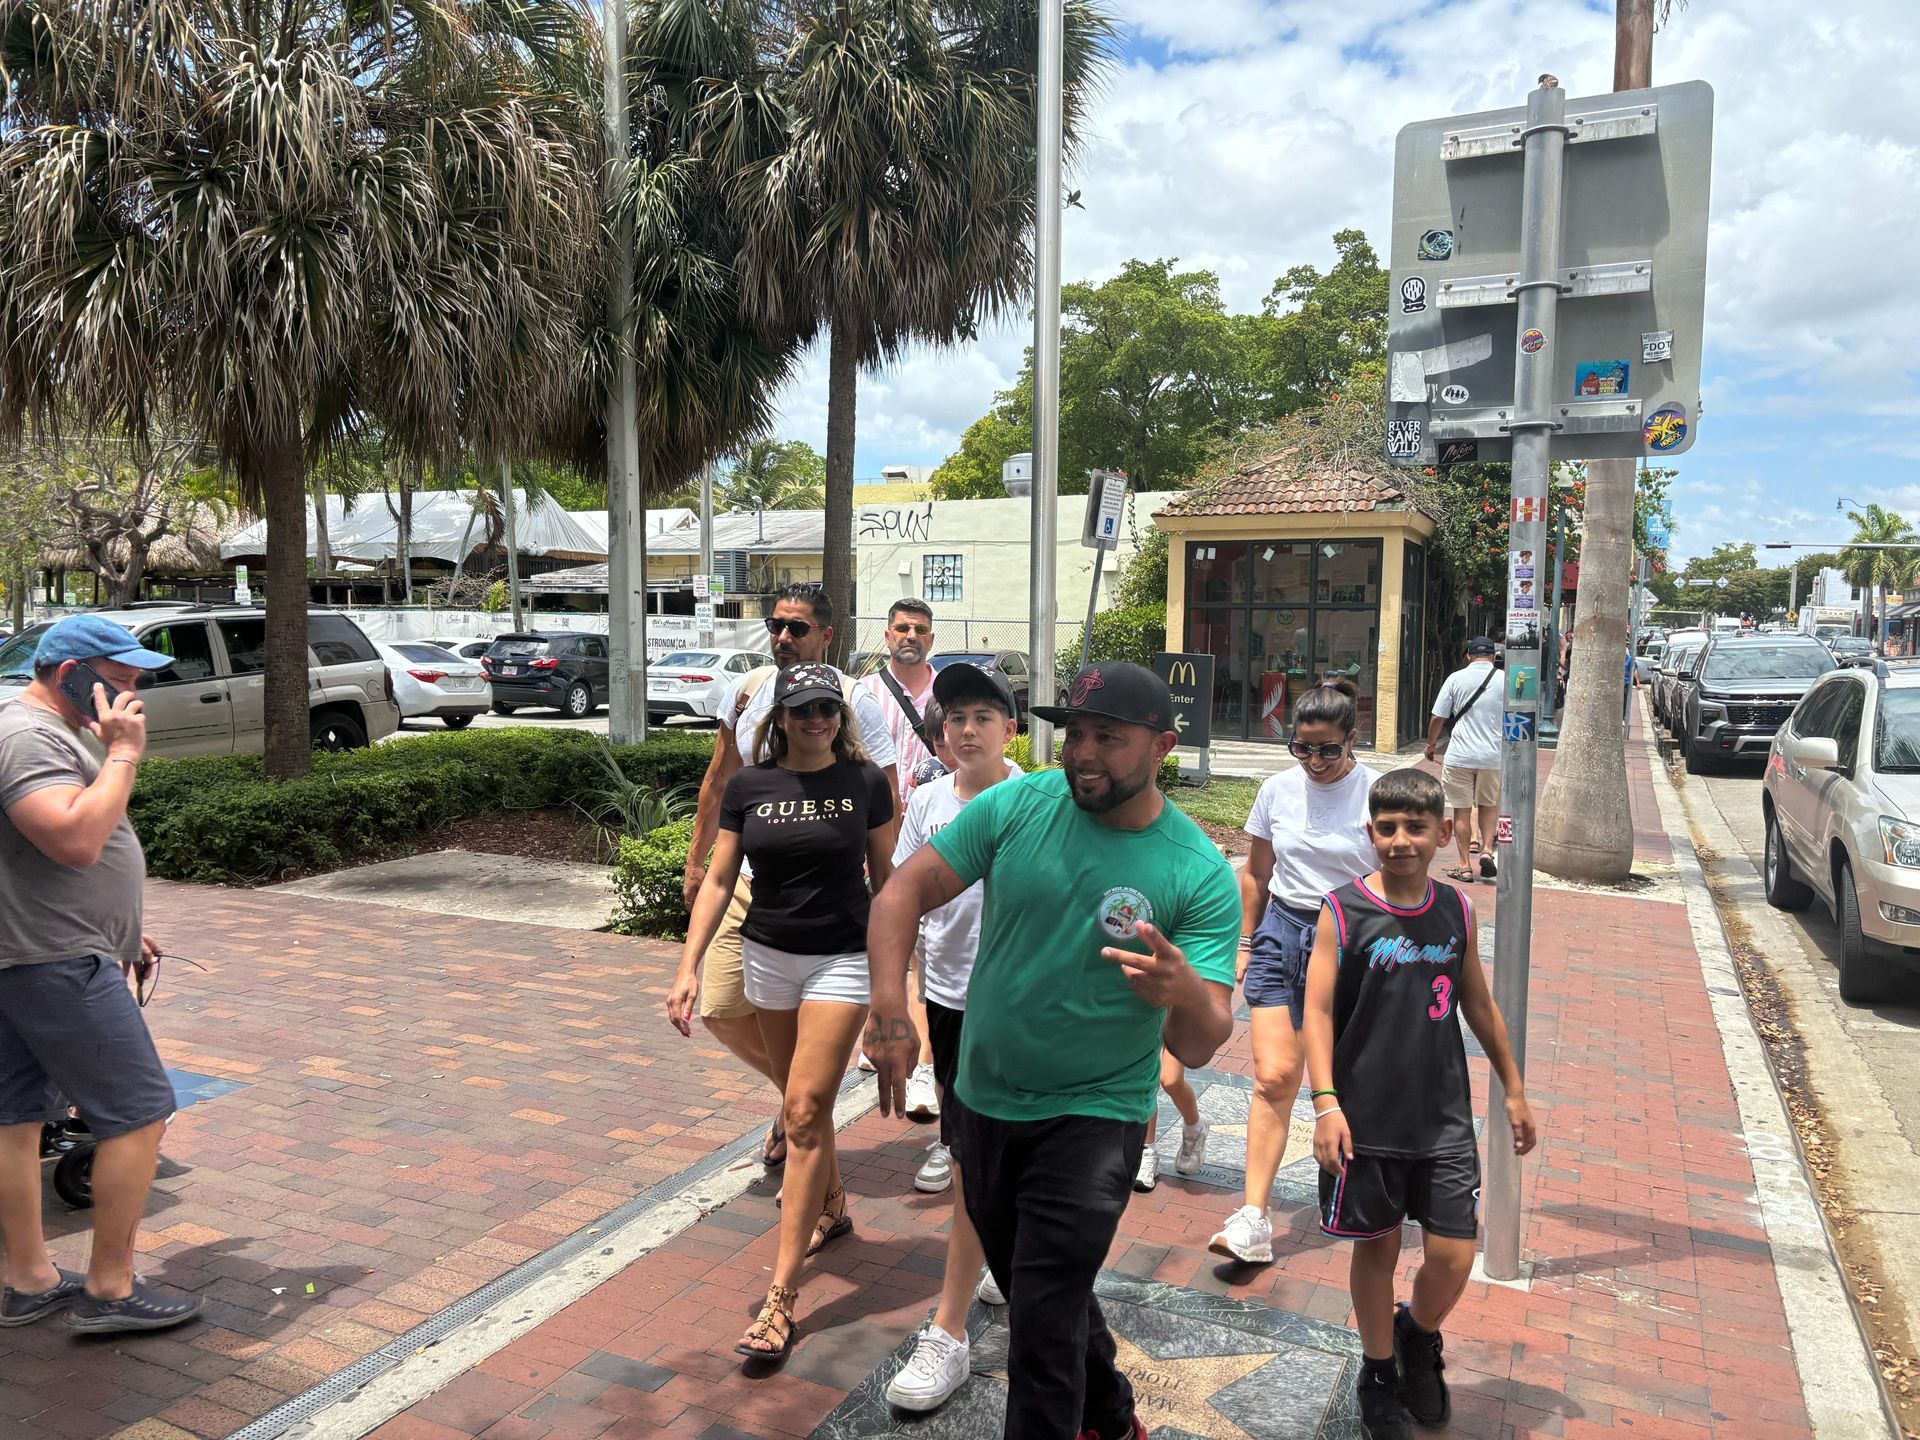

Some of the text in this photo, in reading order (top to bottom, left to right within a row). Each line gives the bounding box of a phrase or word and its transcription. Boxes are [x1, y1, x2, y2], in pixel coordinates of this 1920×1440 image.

[1643, 341, 1671, 351] FDOT
[1388, 420, 1421, 431] RIVER
[1387, 430, 1421, 443] SANG
[1387, 441, 1420, 454] WILD
[1169, 693, 1195, 704] Enter
[756, 799, 854, 817] GUESS
[792, 812, 839, 822] ANGELES
[1364, 935, 1457, 973] Miami
[1428, 974, 1453, 1020] 3
